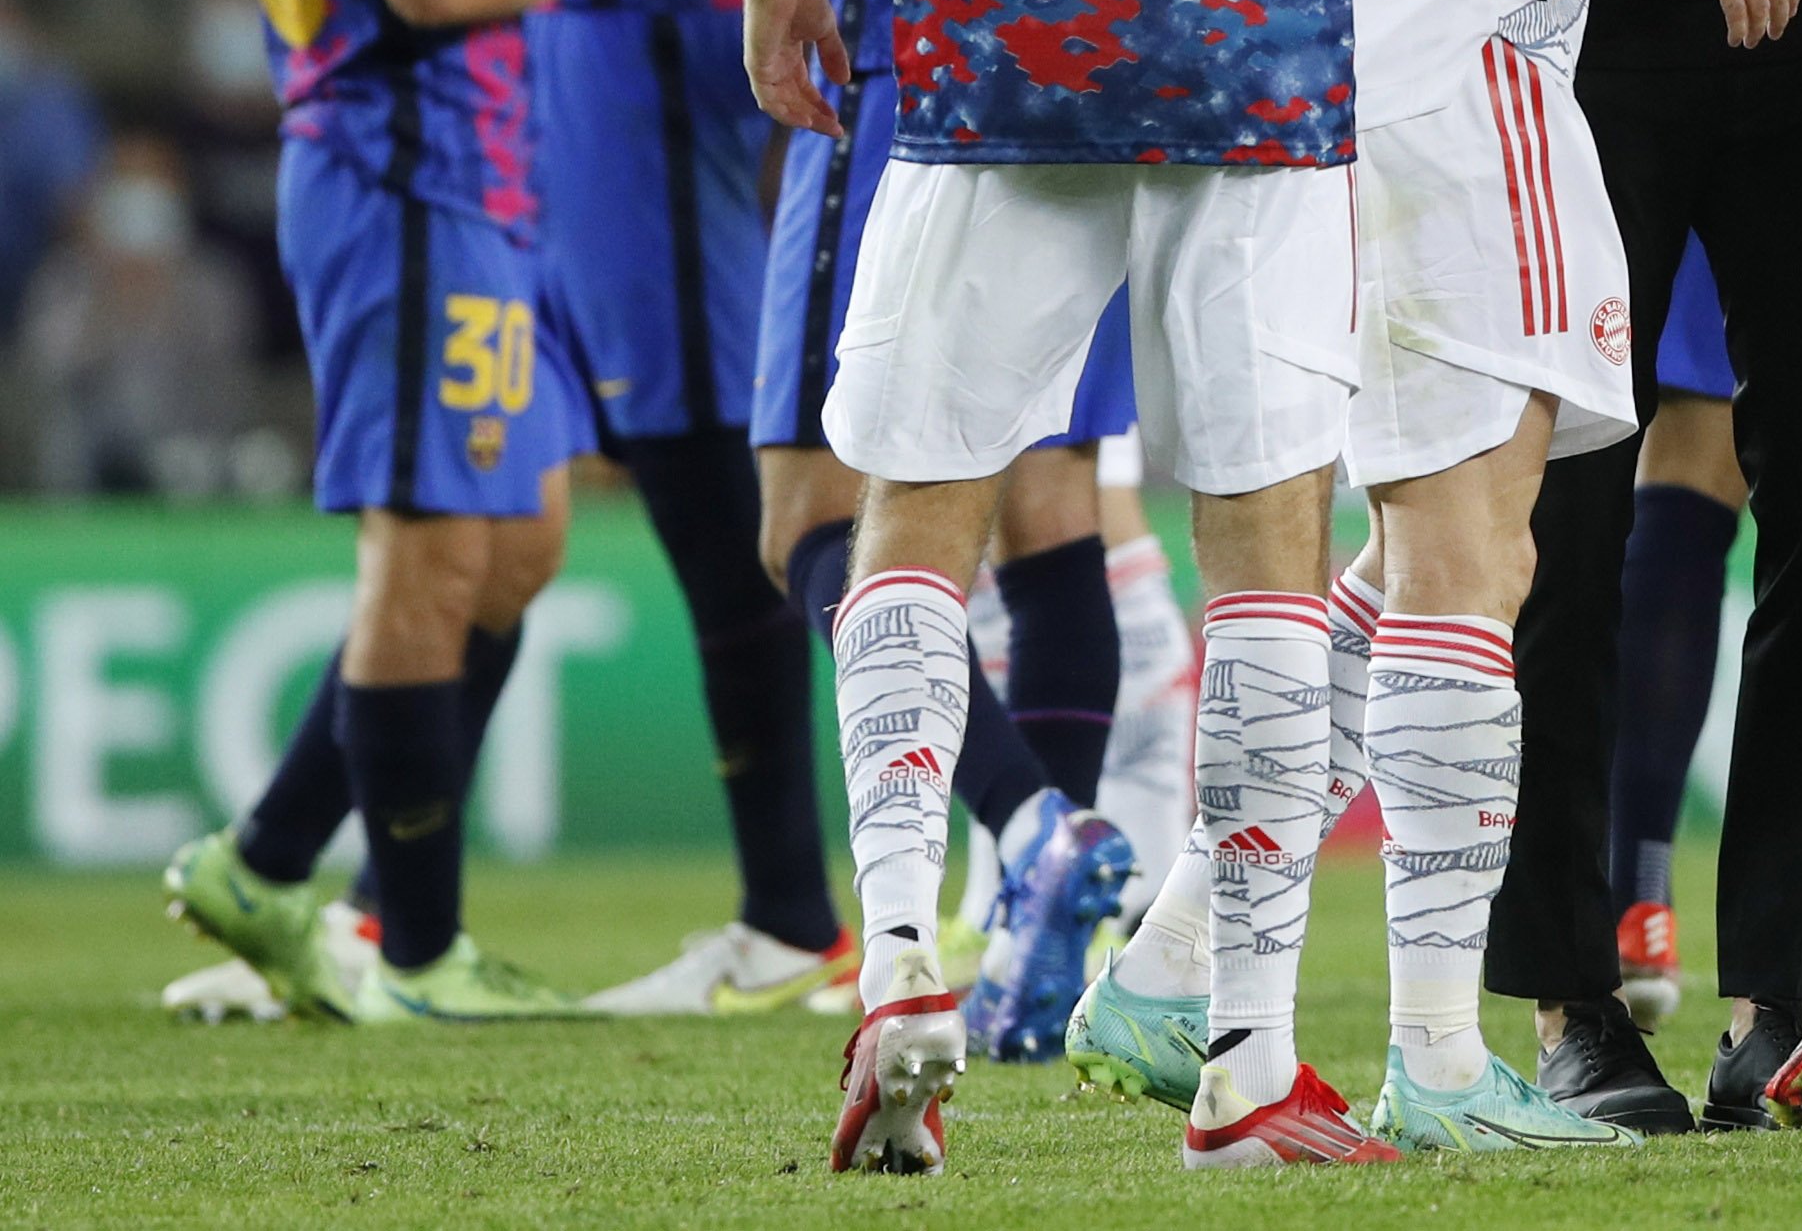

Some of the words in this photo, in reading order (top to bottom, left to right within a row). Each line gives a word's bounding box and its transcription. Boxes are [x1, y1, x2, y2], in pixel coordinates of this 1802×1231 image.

[440, 293, 534, 414] 30
[0, 581, 632, 865] ECT
[1213, 848, 1294, 865] adidas
